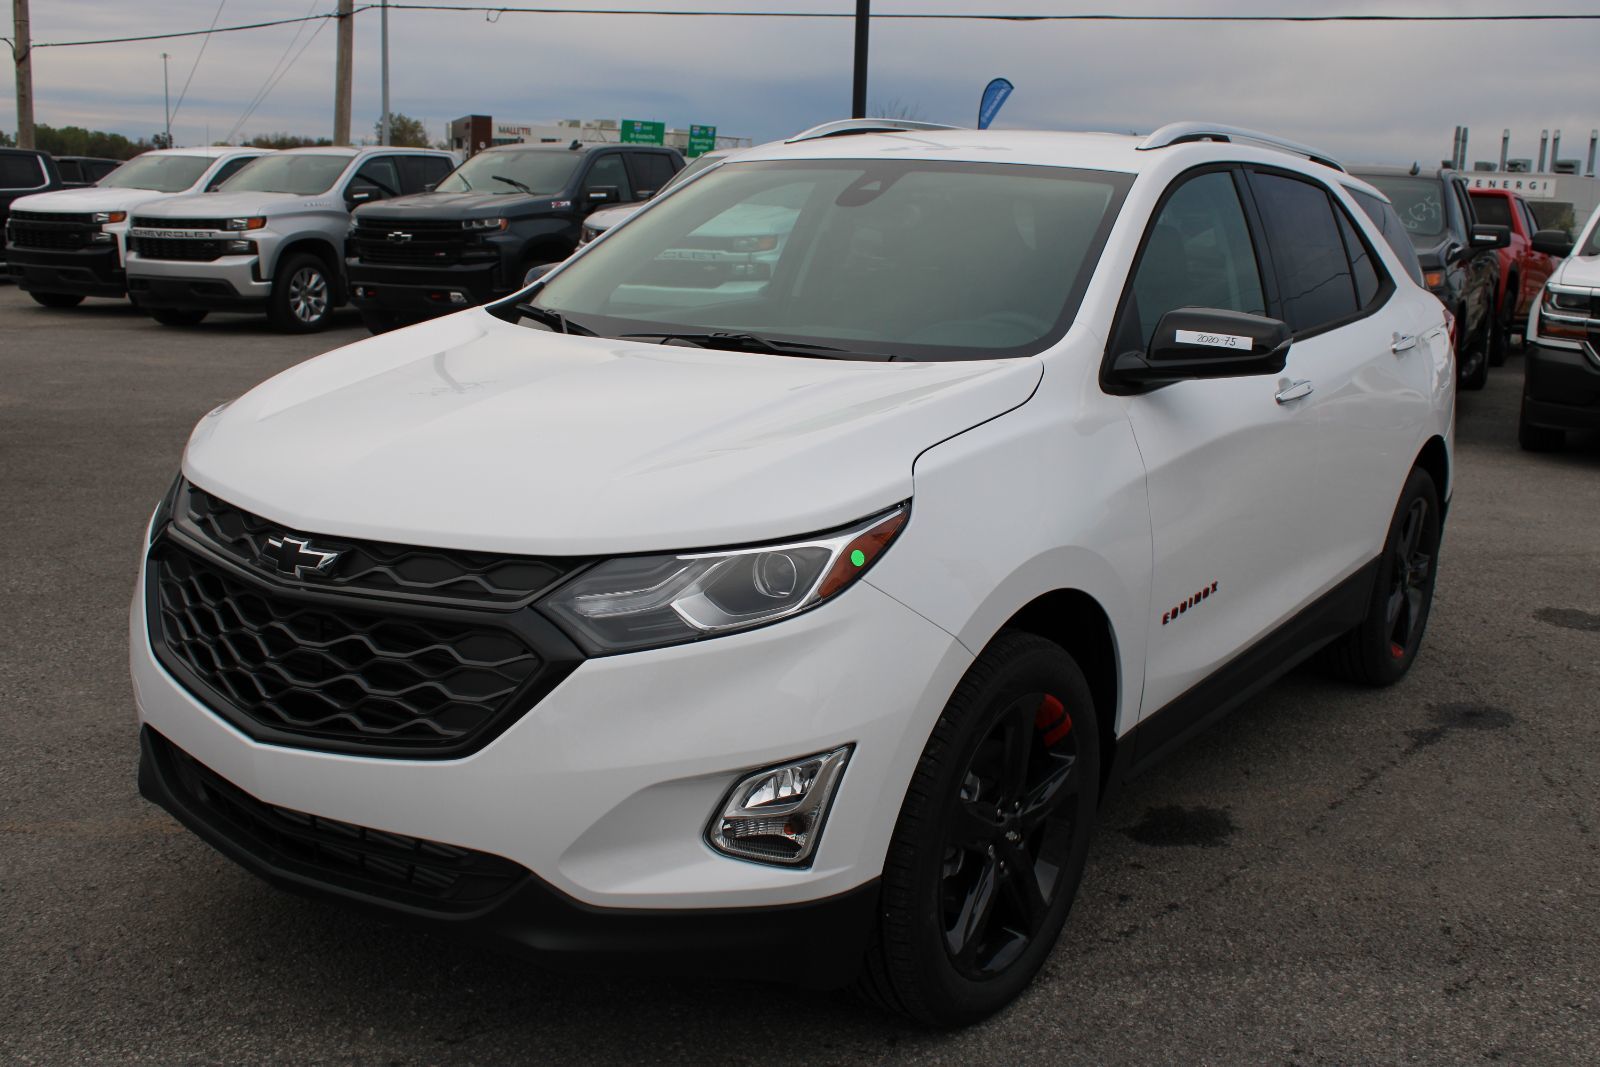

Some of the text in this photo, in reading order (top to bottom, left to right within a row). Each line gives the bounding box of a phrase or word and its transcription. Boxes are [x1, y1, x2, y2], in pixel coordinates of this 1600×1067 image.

[498, 125, 532, 136] MALLETTE
[132, 230, 215, 238] CHEVROLET
[1162, 581, 1218, 625] EQUINOX
